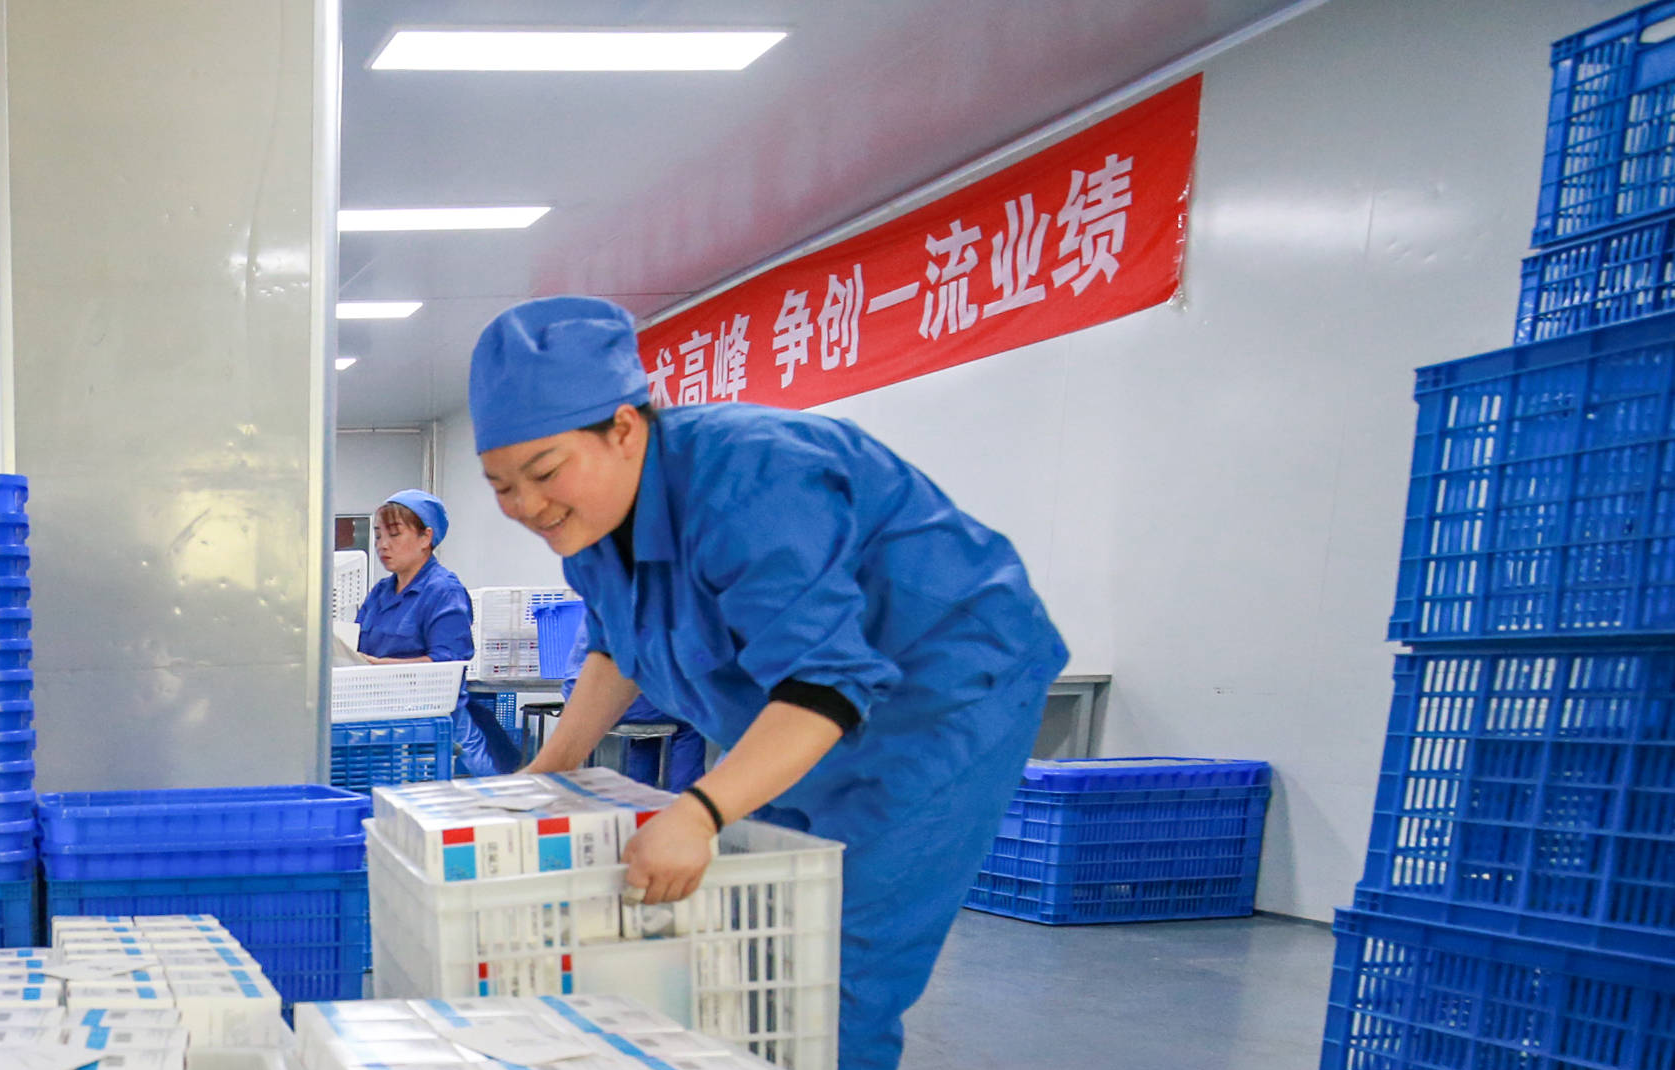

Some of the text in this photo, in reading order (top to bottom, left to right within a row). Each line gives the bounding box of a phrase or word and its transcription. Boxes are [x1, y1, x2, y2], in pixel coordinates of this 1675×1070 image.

[772, 153, 1134, 389] 争创一流业绩
